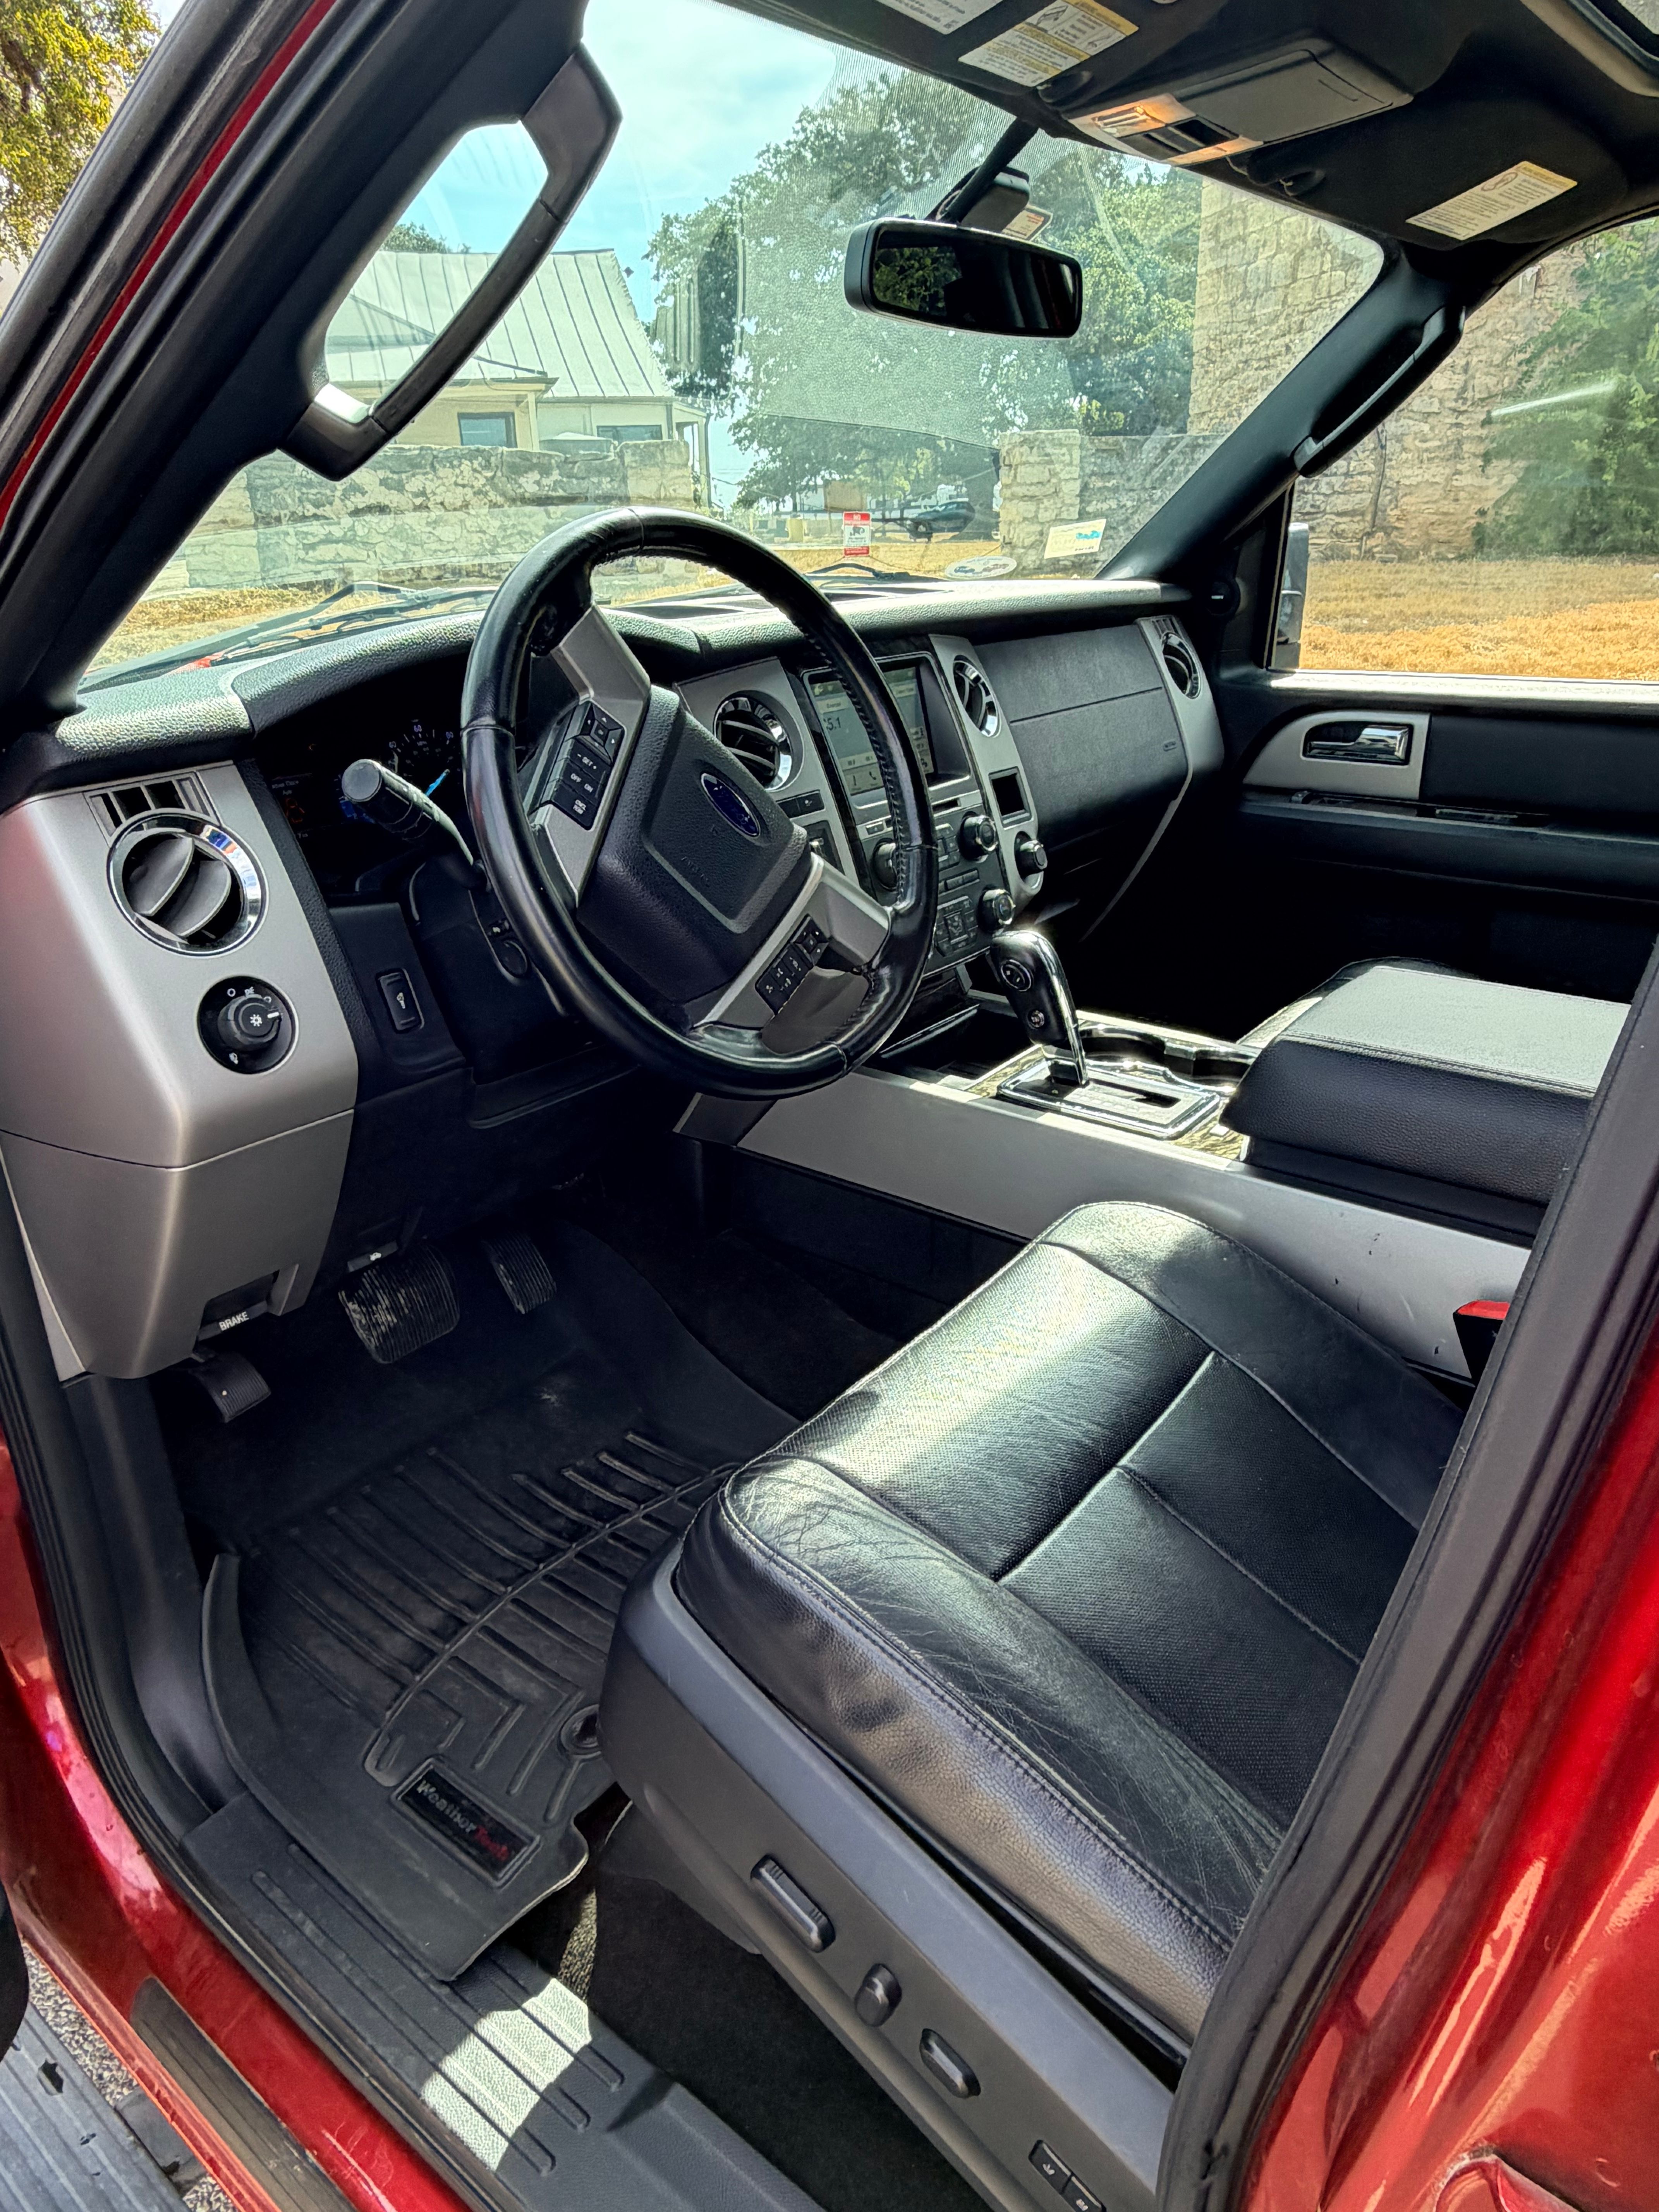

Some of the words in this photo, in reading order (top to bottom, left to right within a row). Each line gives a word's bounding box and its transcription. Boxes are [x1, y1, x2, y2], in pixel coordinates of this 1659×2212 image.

[571, 773, 582, 782] OFF
[584, 783, 593, 792] ON
[219, 1311, 249, 1331] BRAKE
